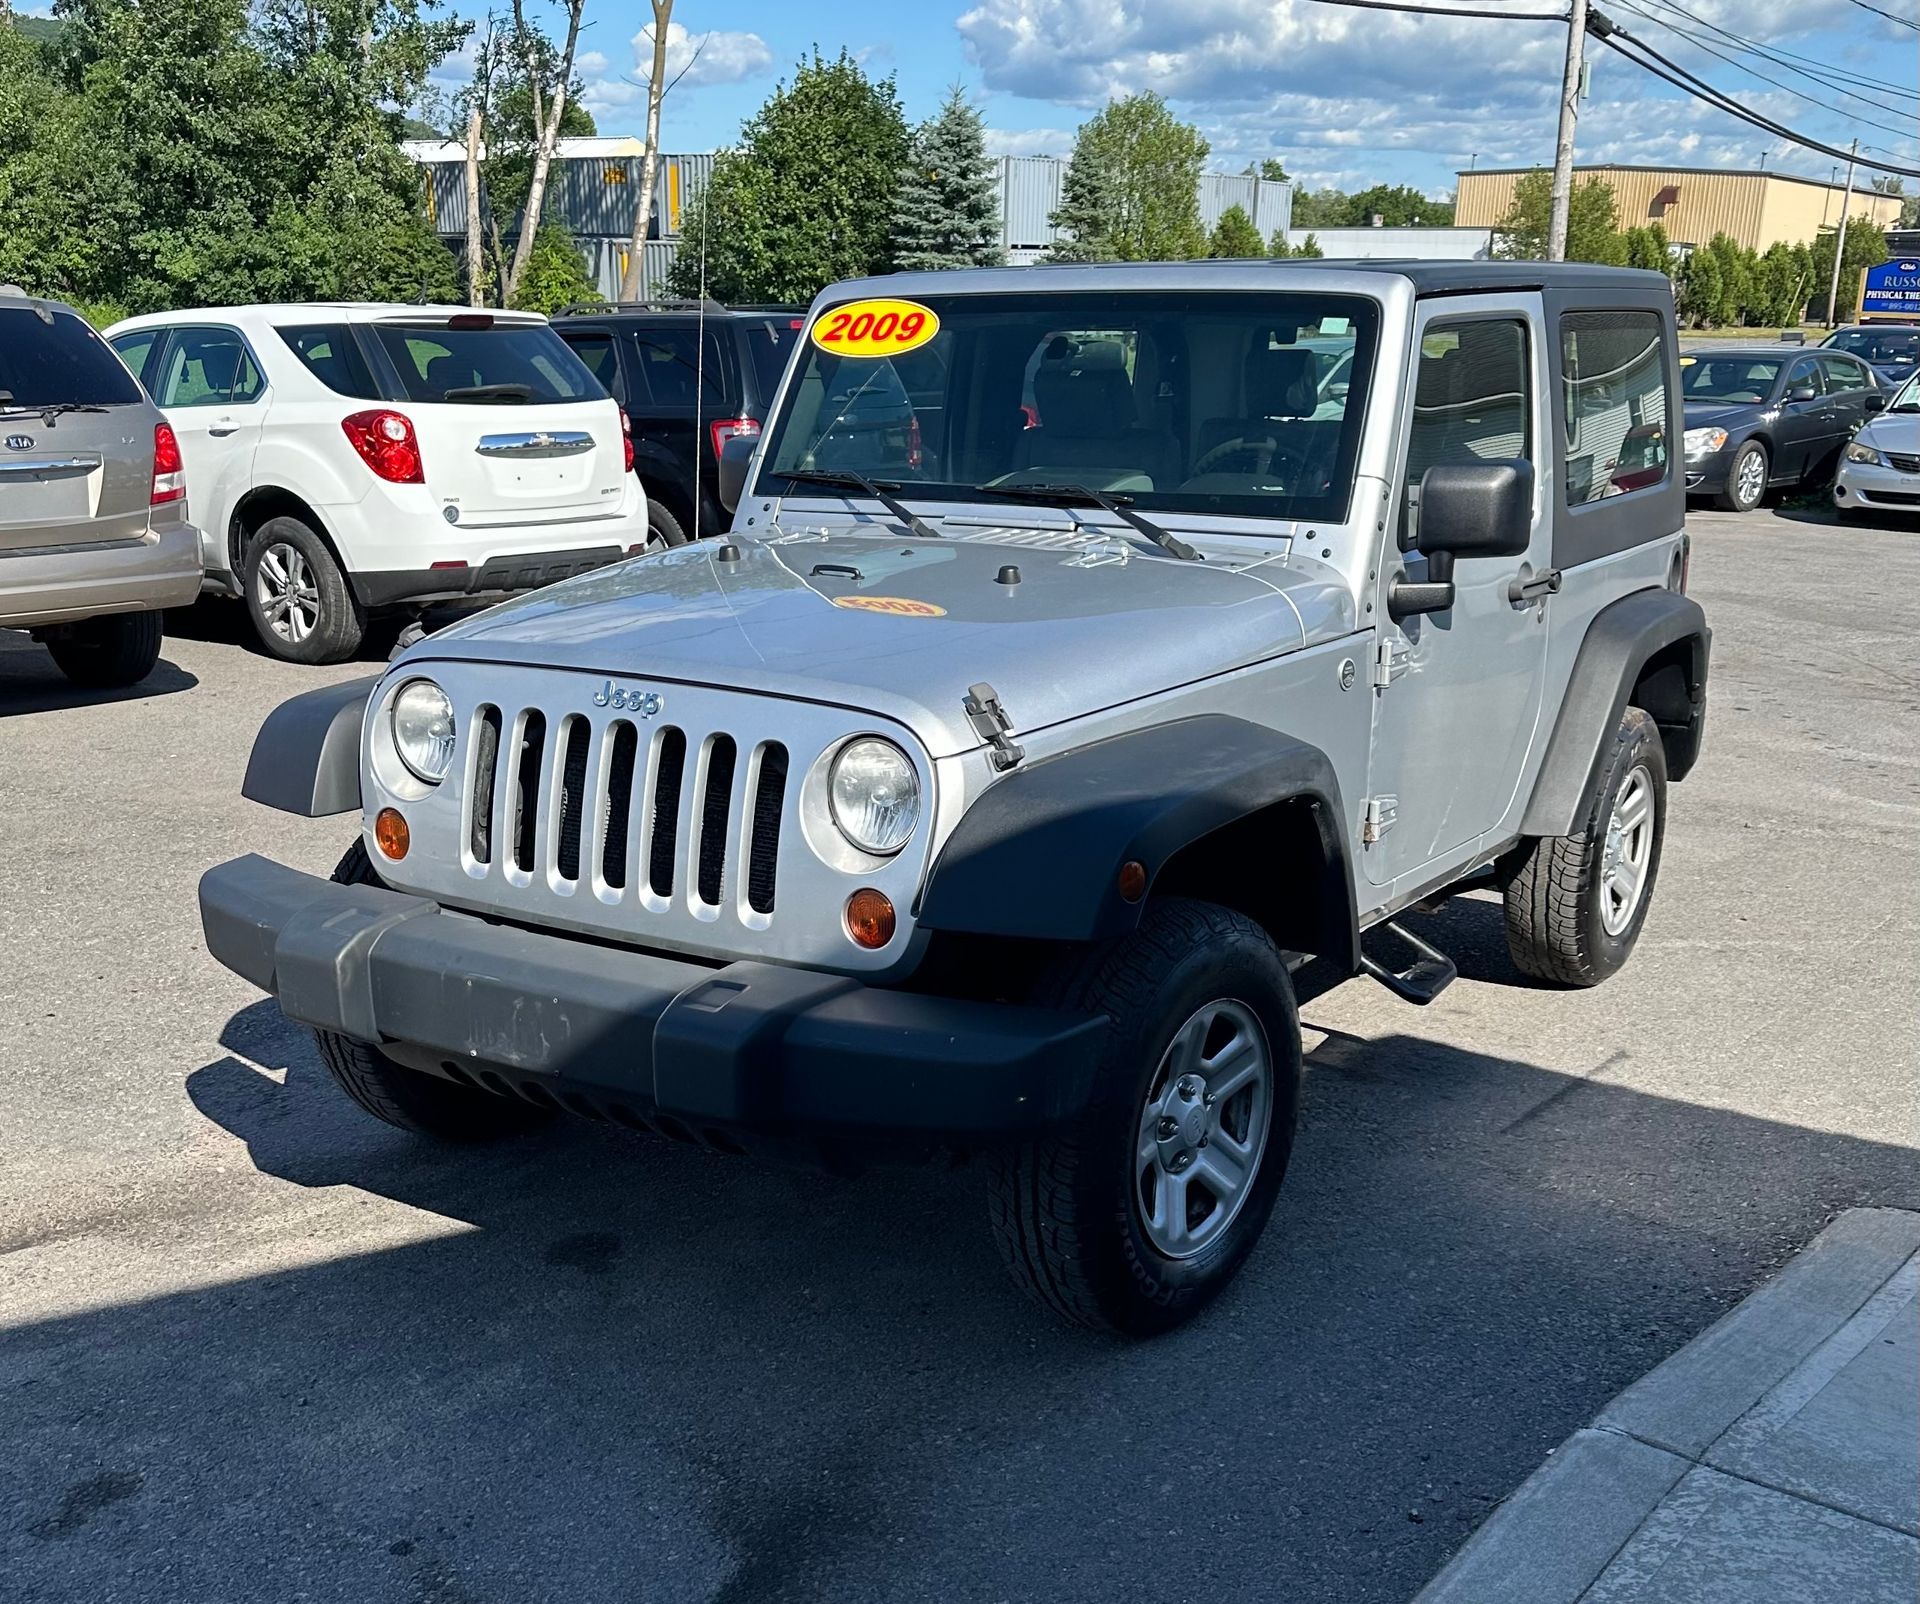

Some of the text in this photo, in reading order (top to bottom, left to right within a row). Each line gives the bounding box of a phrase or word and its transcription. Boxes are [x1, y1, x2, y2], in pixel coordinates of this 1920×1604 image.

[1865, 290, 1904, 299] PHYSICAL
[820, 312, 926, 342] 2009
[9, 437, 33, 448] KIA
[592, 680, 664, 720] Jeep
